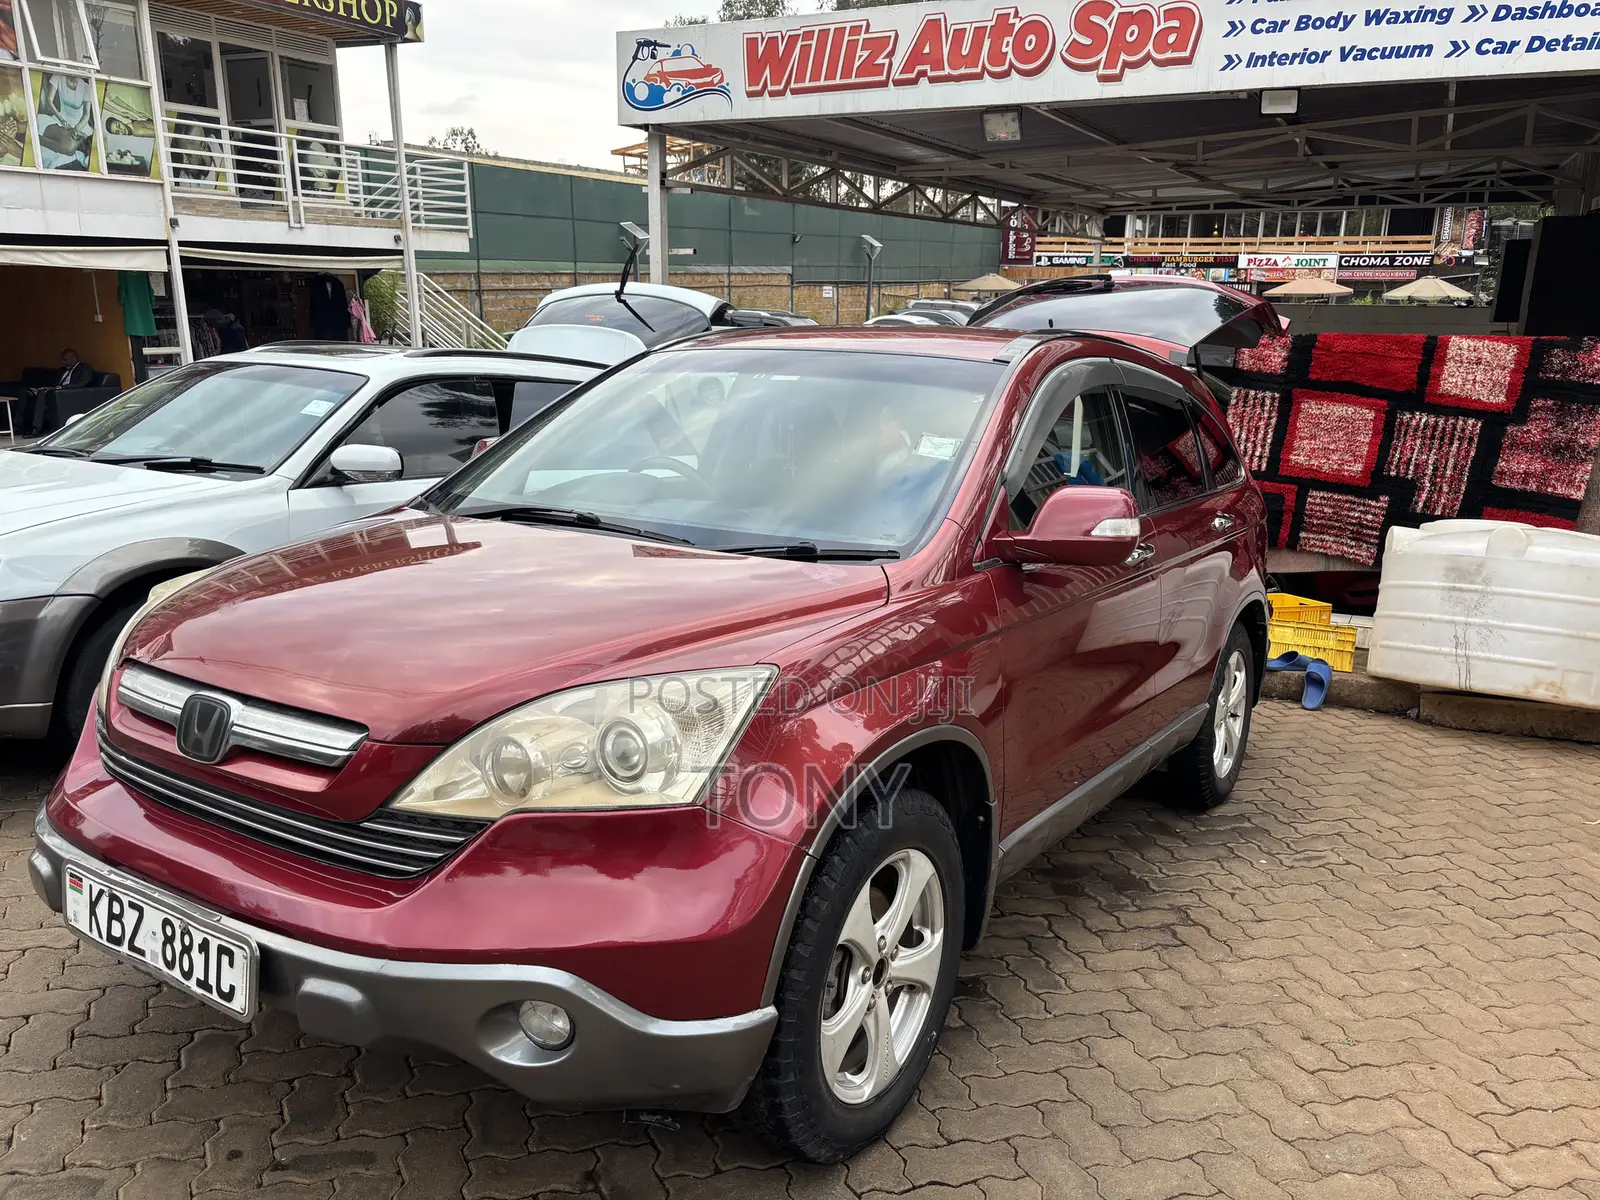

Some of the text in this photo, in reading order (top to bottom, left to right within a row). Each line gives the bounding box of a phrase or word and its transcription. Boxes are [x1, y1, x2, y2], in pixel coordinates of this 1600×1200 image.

[285, 0, 398, 28] SHOP
[1250, 5, 1455, 35] Car Body Waxing
[743, 0, 1204, 98] Williz Auto Spa
[1245, 43, 1434, 69] Interior Vacuum
[1475, 37, 1521, 56] Car
[1052, 257, 1087, 265] GAMING
[1246, 257, 1329, 267] PIZZA JOINT
[1341, 256, 1432, 266] CHOMA ZONE
[88, 883, 146, 958] KBZ
[161, 916, 236, 1003] 881C
